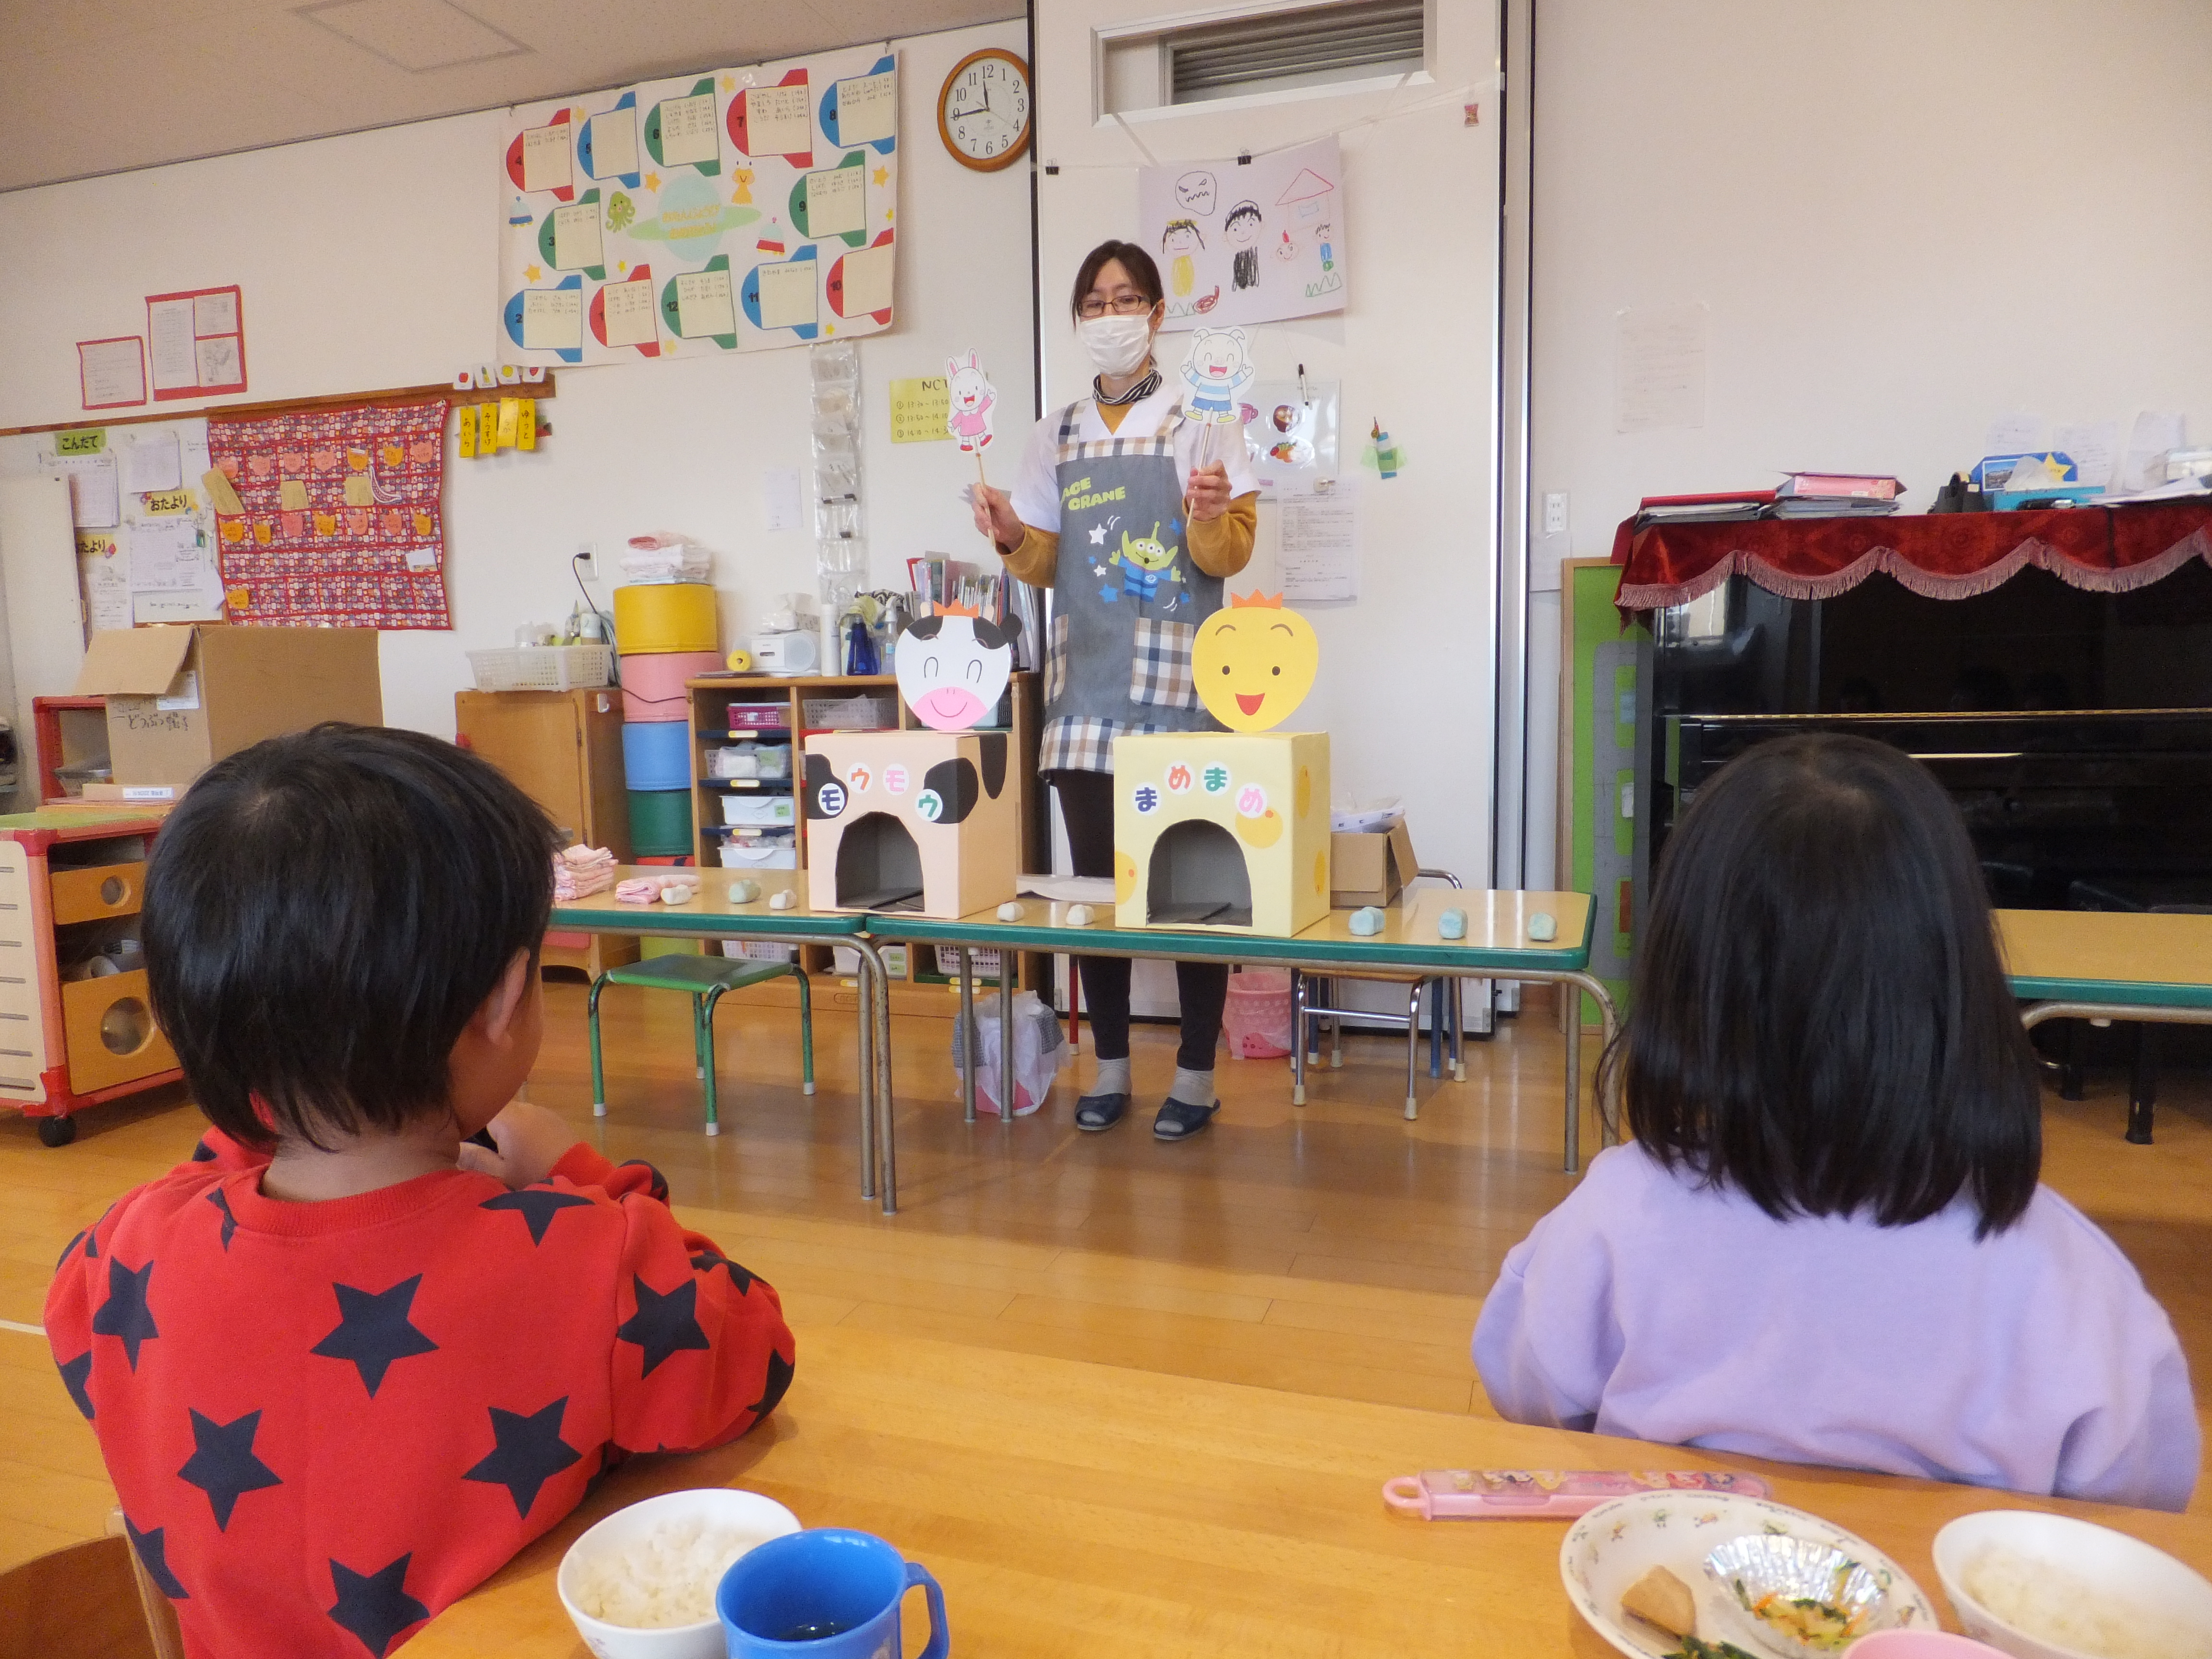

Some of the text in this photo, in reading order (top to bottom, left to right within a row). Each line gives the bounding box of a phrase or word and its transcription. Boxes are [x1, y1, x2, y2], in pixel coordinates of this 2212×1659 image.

[982, 64, 994, 79] 12
[1002, 68, 1006, 81] 1
[968, 72, 977, 86] 11
[1012, 80, 1020, 94] 2
[956, 88, 967, 102] 10
[1017, 98, 1025, 112] 3
[829, 108, 836, 121] 8
[953, 108, 960, 121] 9
[737, 116, 745, 127] 7
[1013, 119, 1020, 132] 4
[958, 126, 965, 139] 8
[971, 139, 977, 152] 7
[986, 141, 993, 155] 6
[1001, 135, 1009, 148] 5
[516, 156, 522, 166] 4
[798, 201, 806, 212] 9
[549, 236, 555, 246] 3
[830, 280, 842, 291] 10
[748, 292, 759, 303] 11
[666, 301, 678, 312] 12
[515, 313, 523, 323] 2
[62, 435, 98, 450] こんだて
[1060, 477, 1091, 505] ACE
[150, 494, 188, 512] おたより
[1068, 486, 1126, 511] CRANE
[821, 768, 938, 818] モウモウ
[1135, 765, 1263, 814] まめまめ
